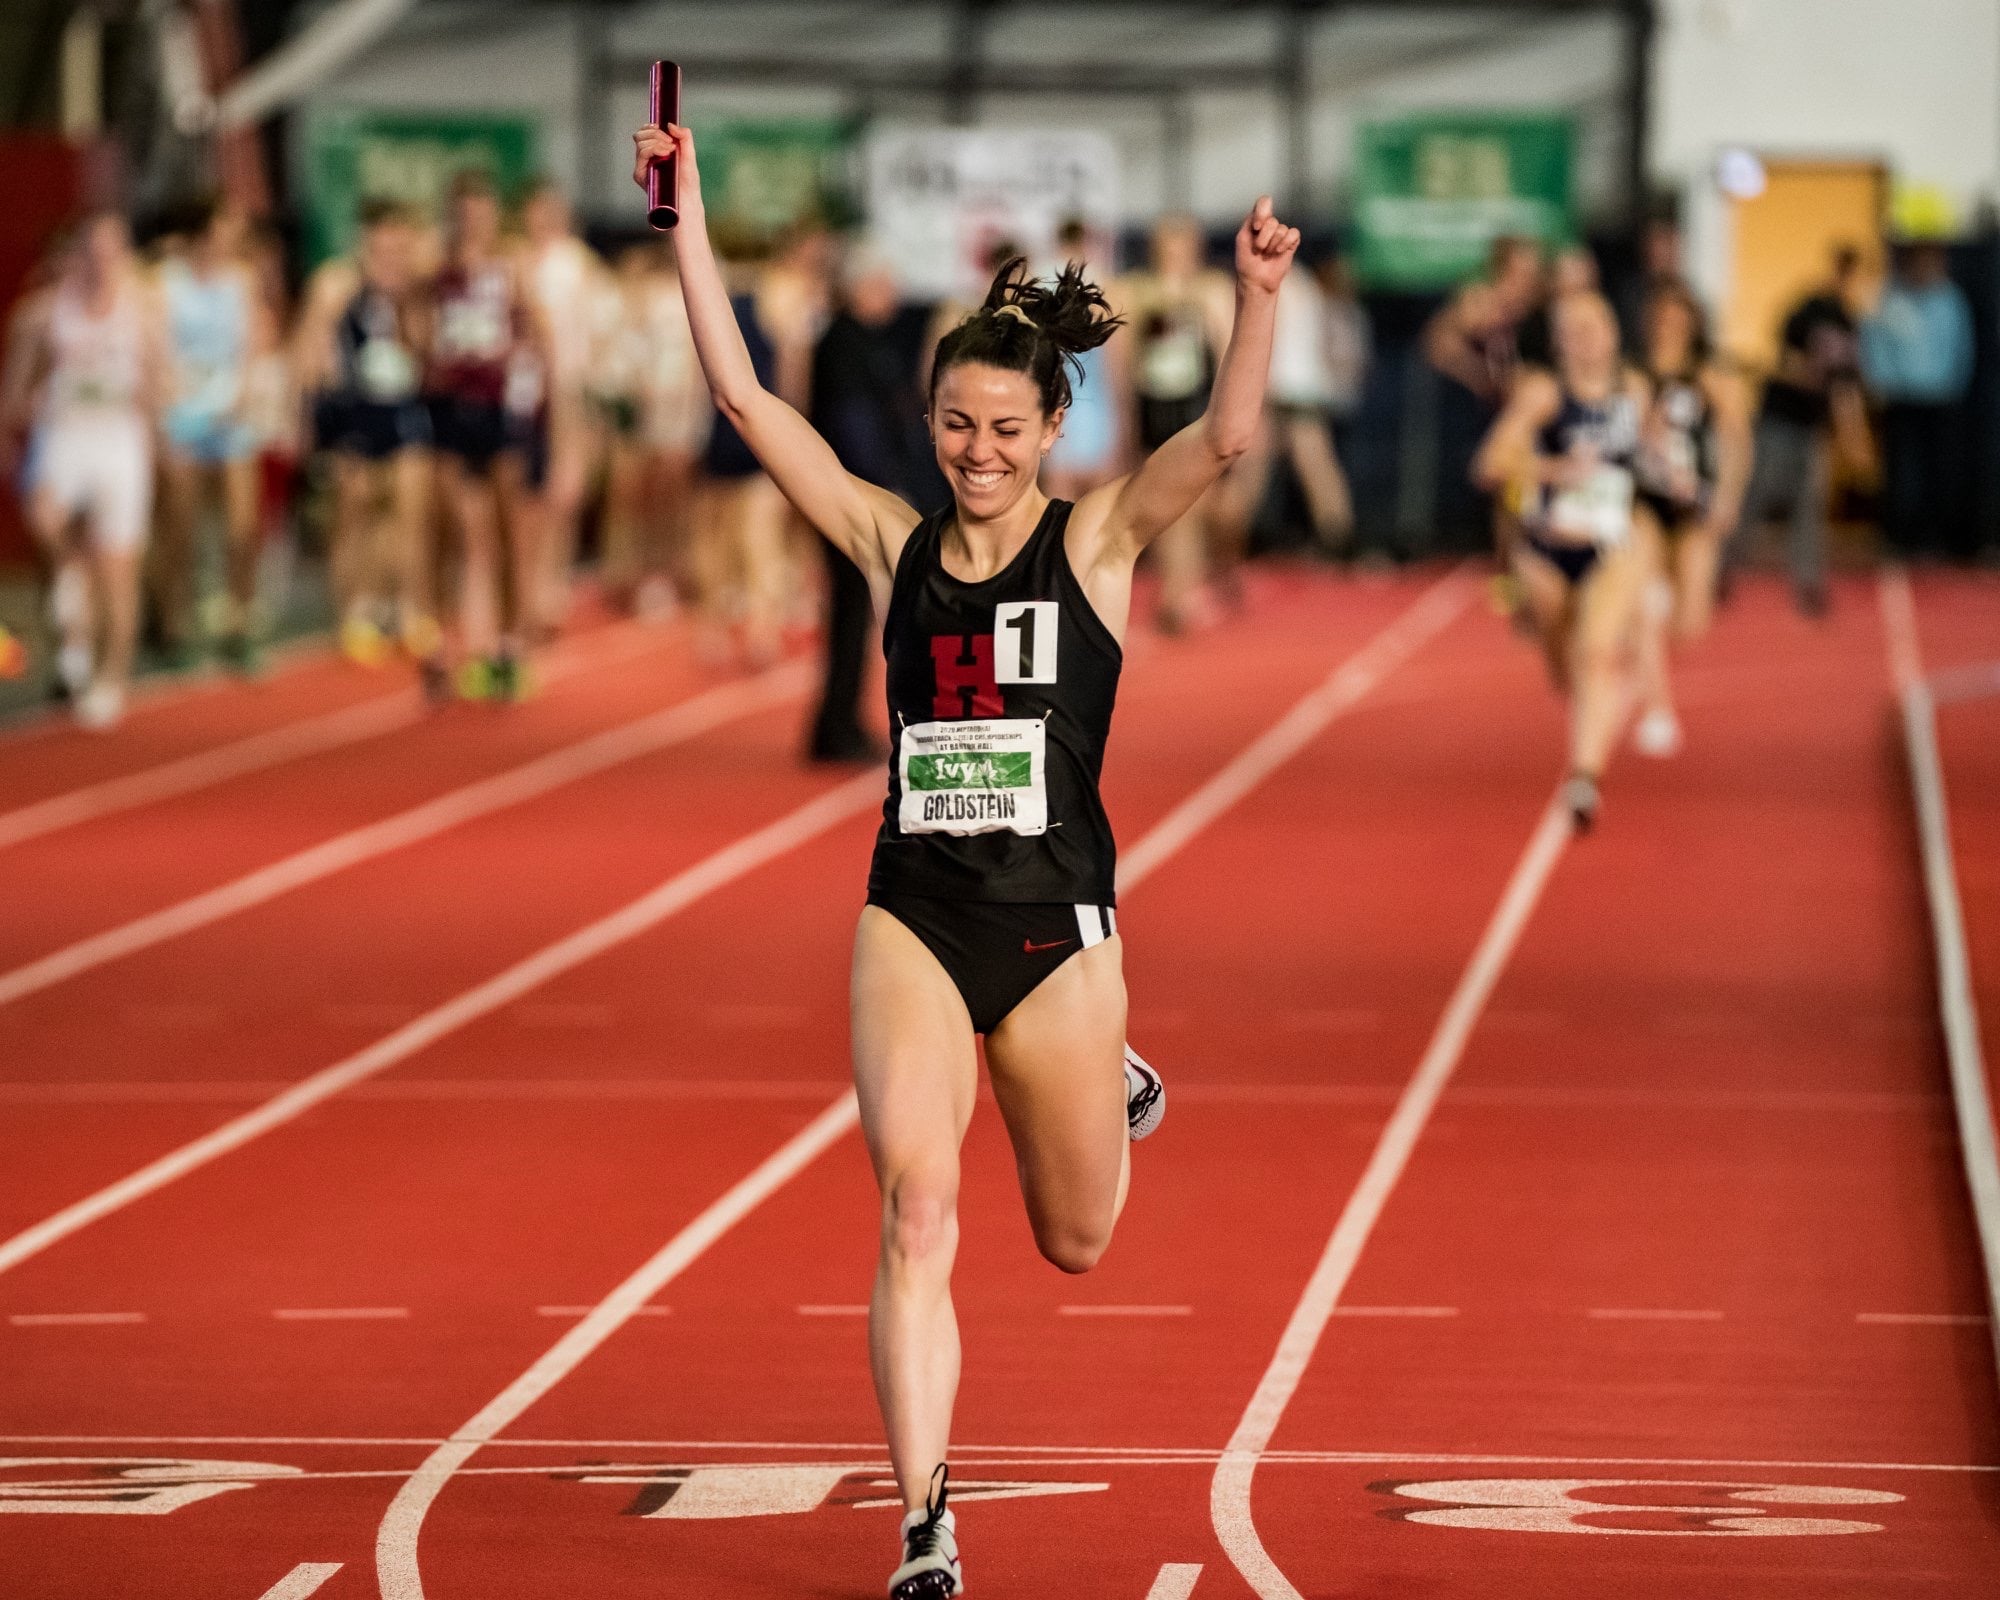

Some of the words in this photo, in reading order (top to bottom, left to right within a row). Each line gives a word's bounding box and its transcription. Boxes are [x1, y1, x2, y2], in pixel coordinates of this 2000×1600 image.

[1006, 608, 1036, 678] 1
[930, 634, 1004, 717] H
[934, 757, 975, 783] Ivy
[924, 793, 1016, 821] GOLDSTEIN
